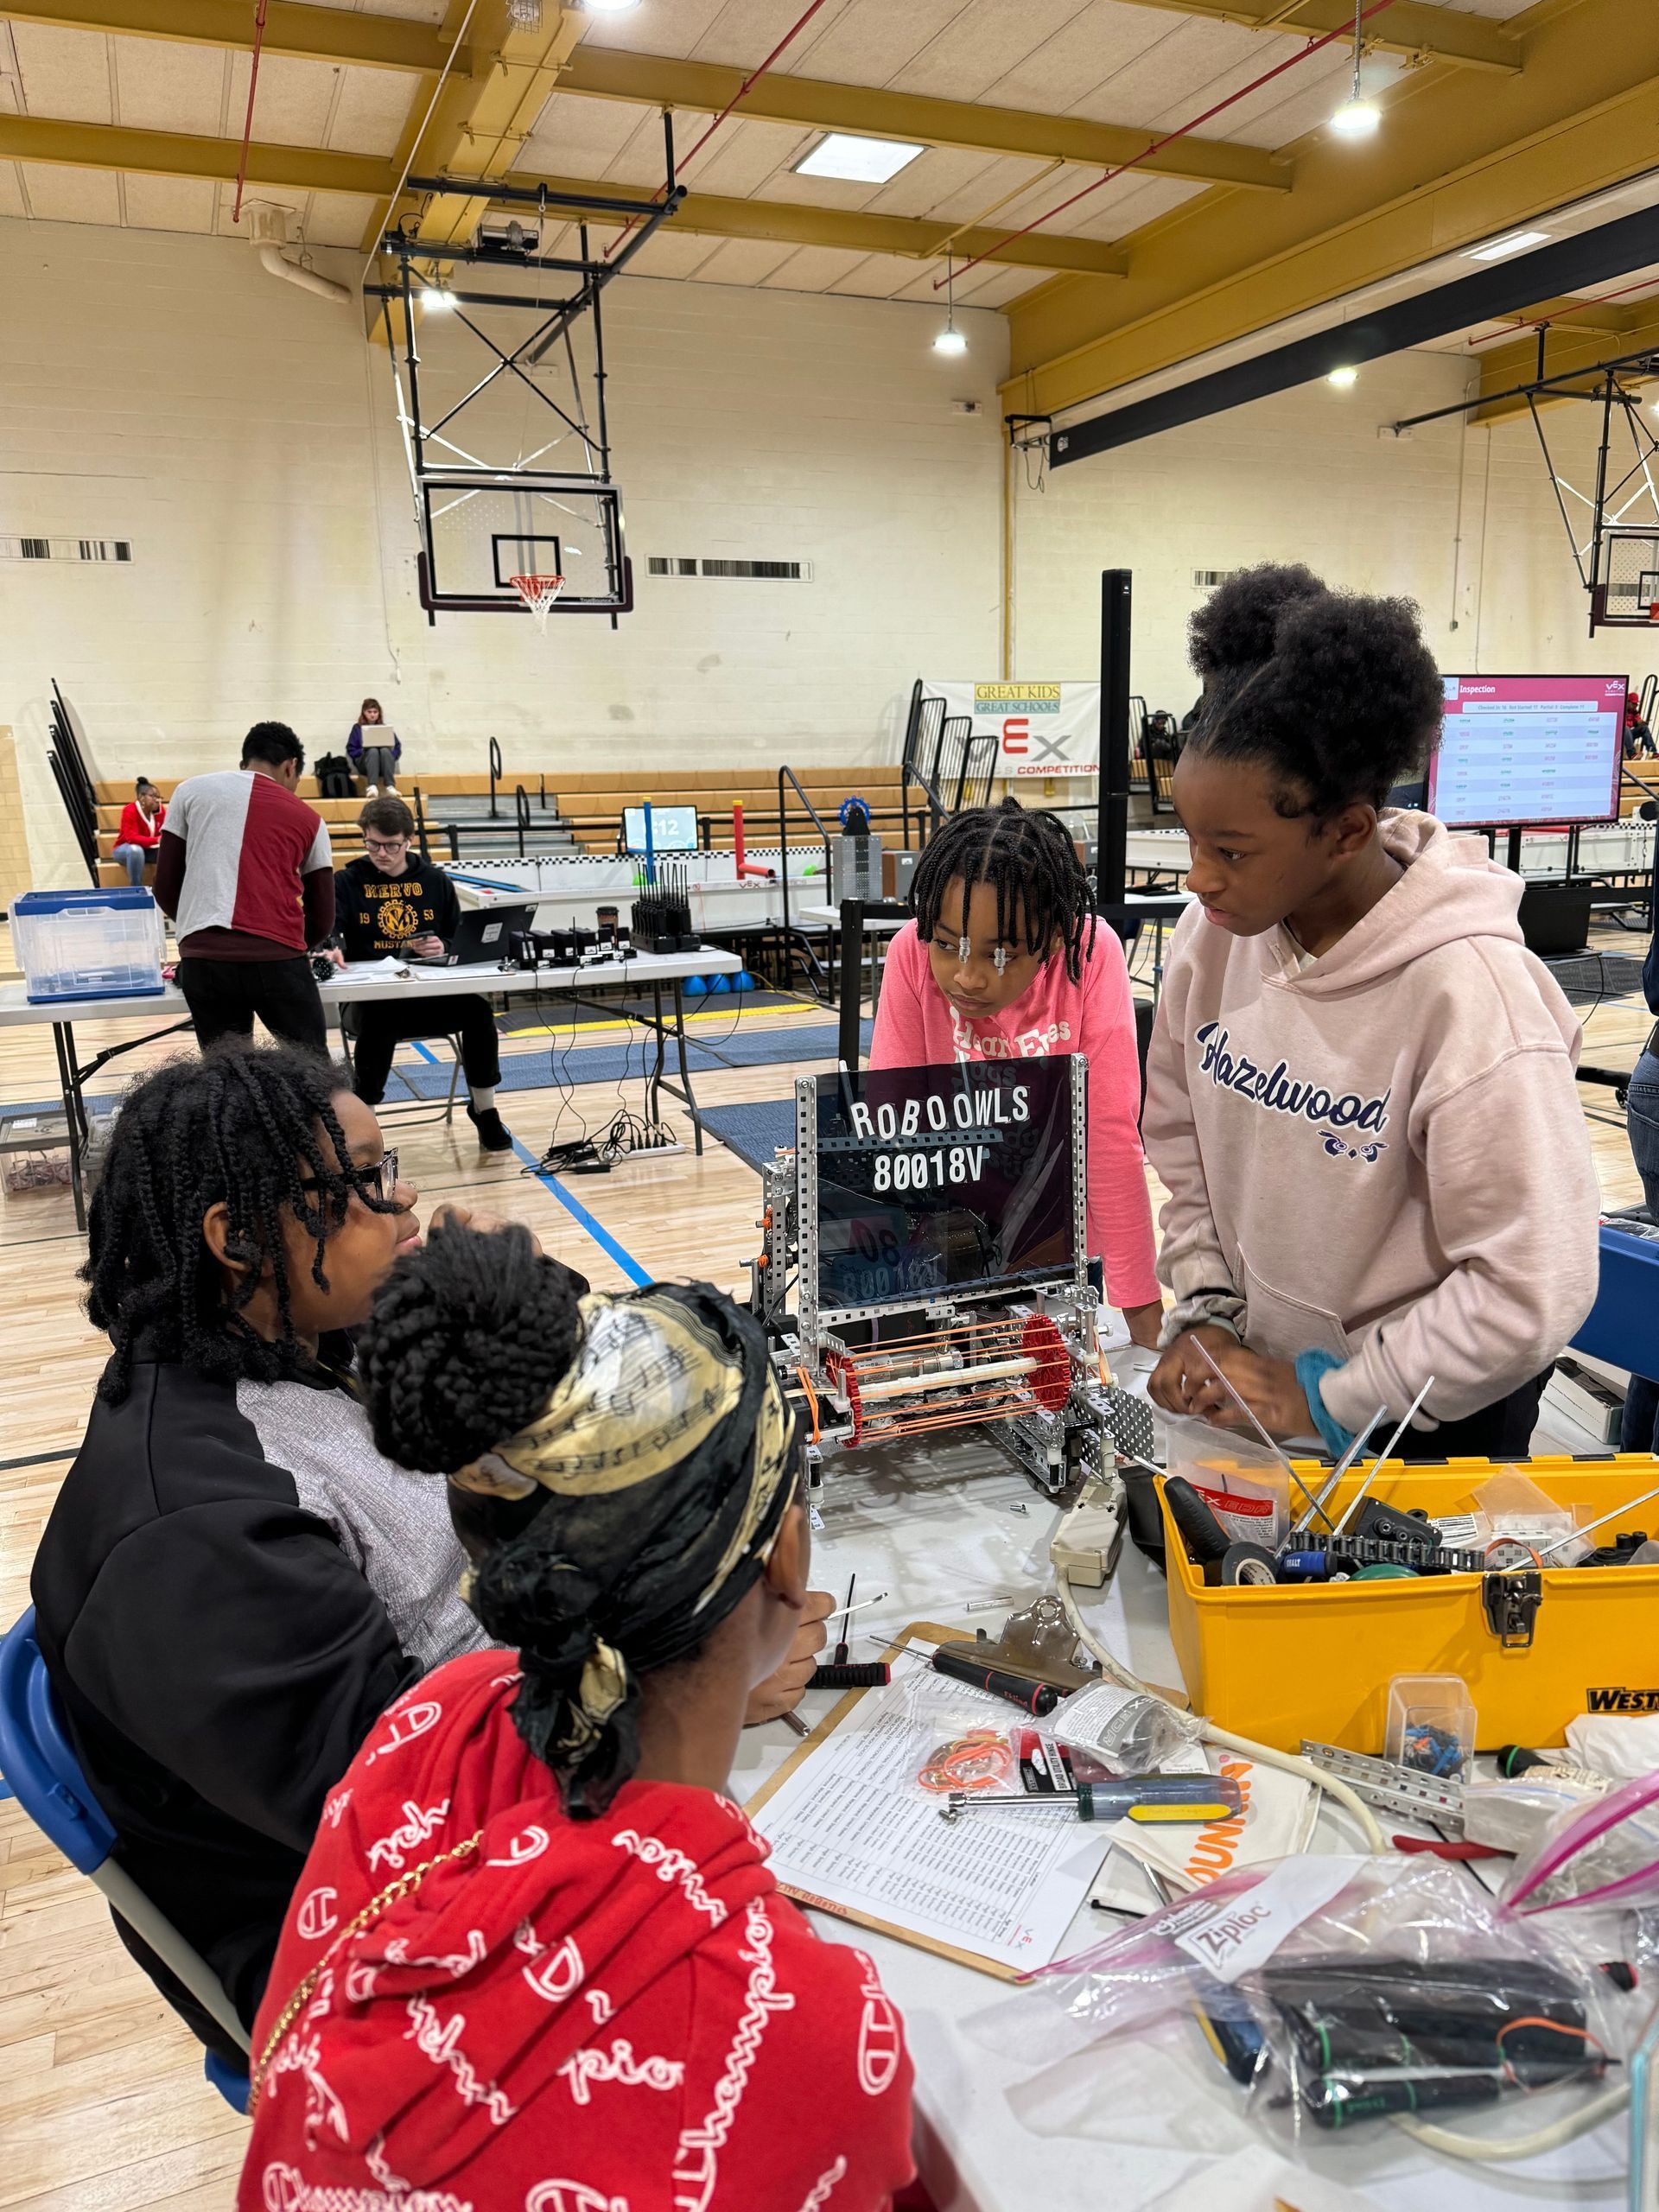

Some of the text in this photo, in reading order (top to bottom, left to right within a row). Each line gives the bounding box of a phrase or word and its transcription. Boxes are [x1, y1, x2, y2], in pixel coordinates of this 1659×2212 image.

[977, 685, 1060, 699] GREAT KIDS
[1459, 685, 1496, 695] Inspection
[976, 702, 1059, 713] GREAT SCHOOLS
[363, 882, 423, 899] MERVO
[359, 910, 434, 925] 19 53
[373, 939, 415, 950] MUSTAN
[1197, 1022, 1392, 1134] Hazelwood
[850, 1086, 1029, 1140] ROBO OWLS
[874, 1146, 985, 1191] 80018V
[1588, 1690, 1659, 1712] WEST
[1045, 1743, 1068, 1789] BROAD UTILITY HINGE
[1014, 1925, 1036, 1953] VEX
[1196, 1905, 1271, 1955] Ziploc
